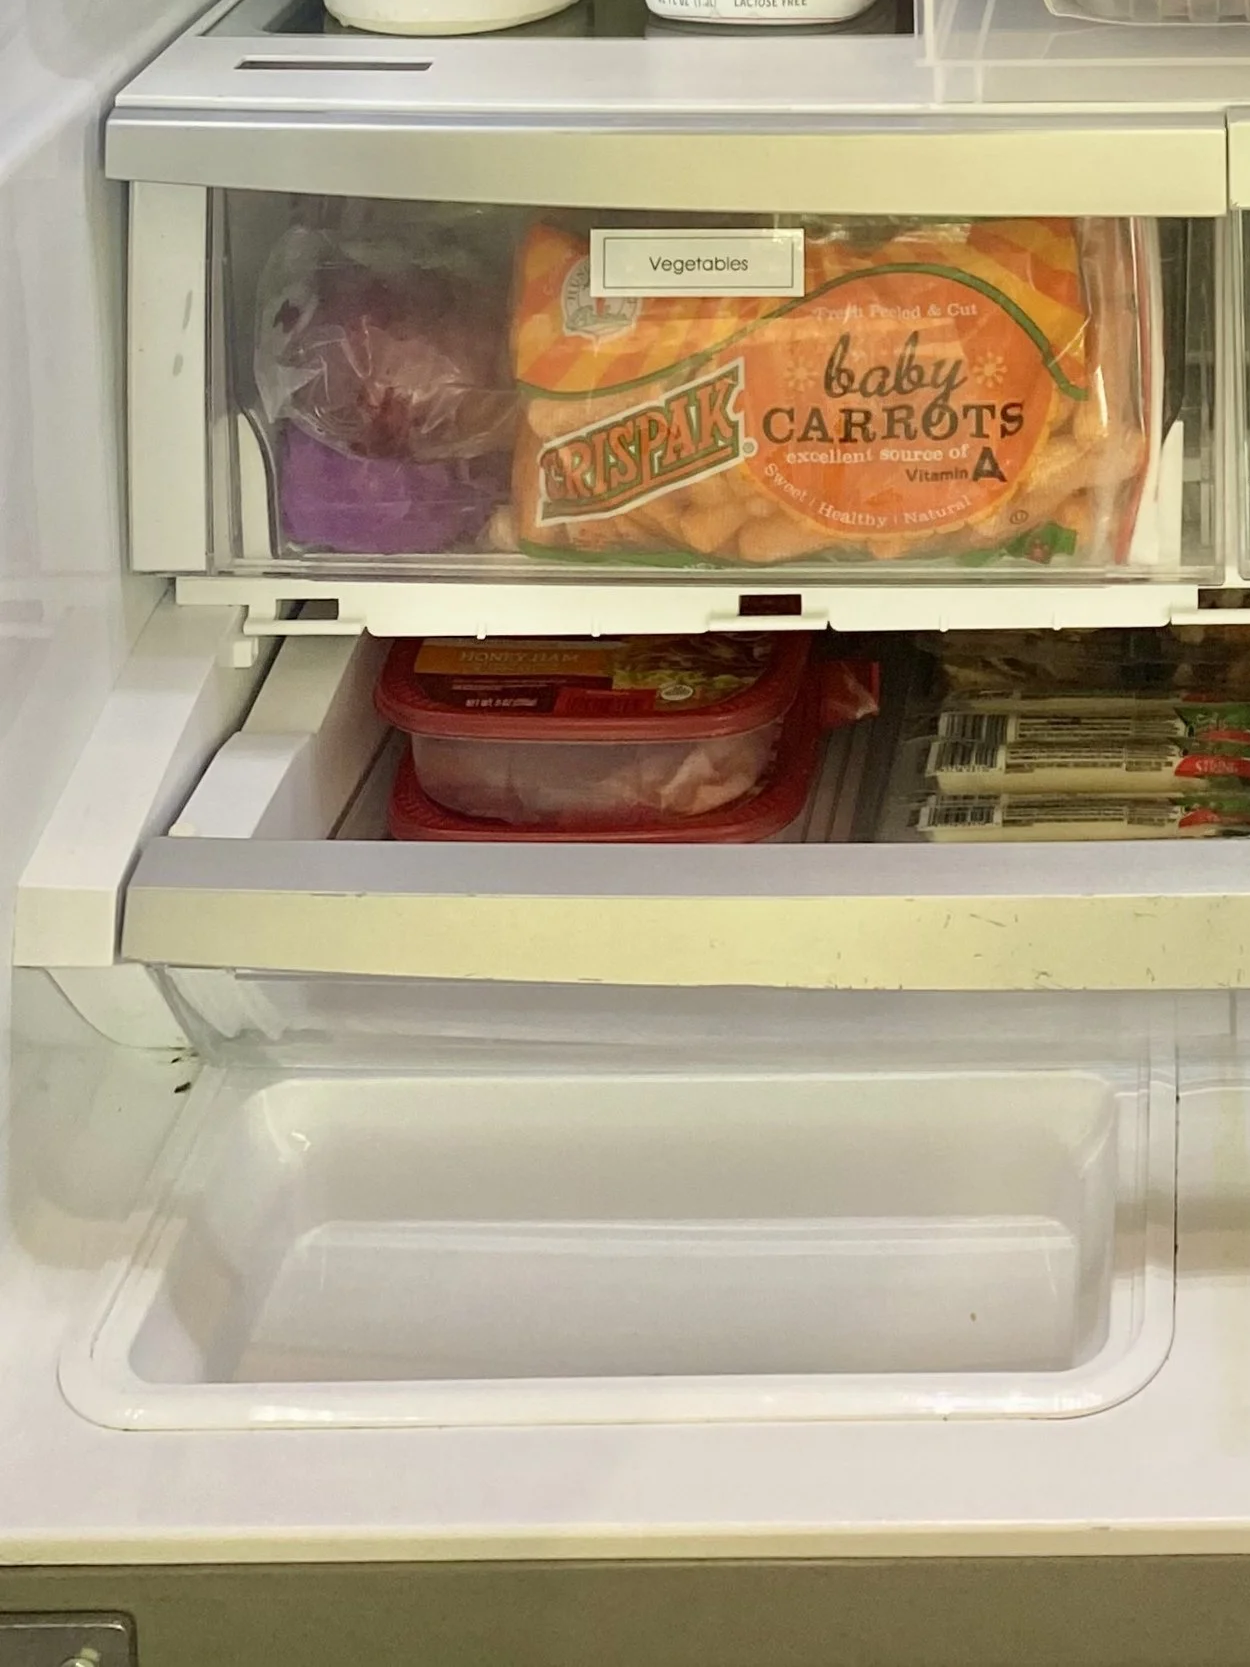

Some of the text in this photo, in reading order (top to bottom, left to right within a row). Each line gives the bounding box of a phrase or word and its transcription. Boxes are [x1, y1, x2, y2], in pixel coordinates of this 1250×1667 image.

[649, 256, 748, 275] Vegetables
[814, 303, 977, 321] Fresh Peeled & Cut
[823, 331, 968, 427] baby
[541, 378, 735, 500] CRISPAK
[762, 402, 1025, 444] CARROTS
[786, 444, 970, 464] excellent source of
[906, 446, 1008, 482] Vitamin A
[764, 463, 972, 528] Sweet Healthy Natural
